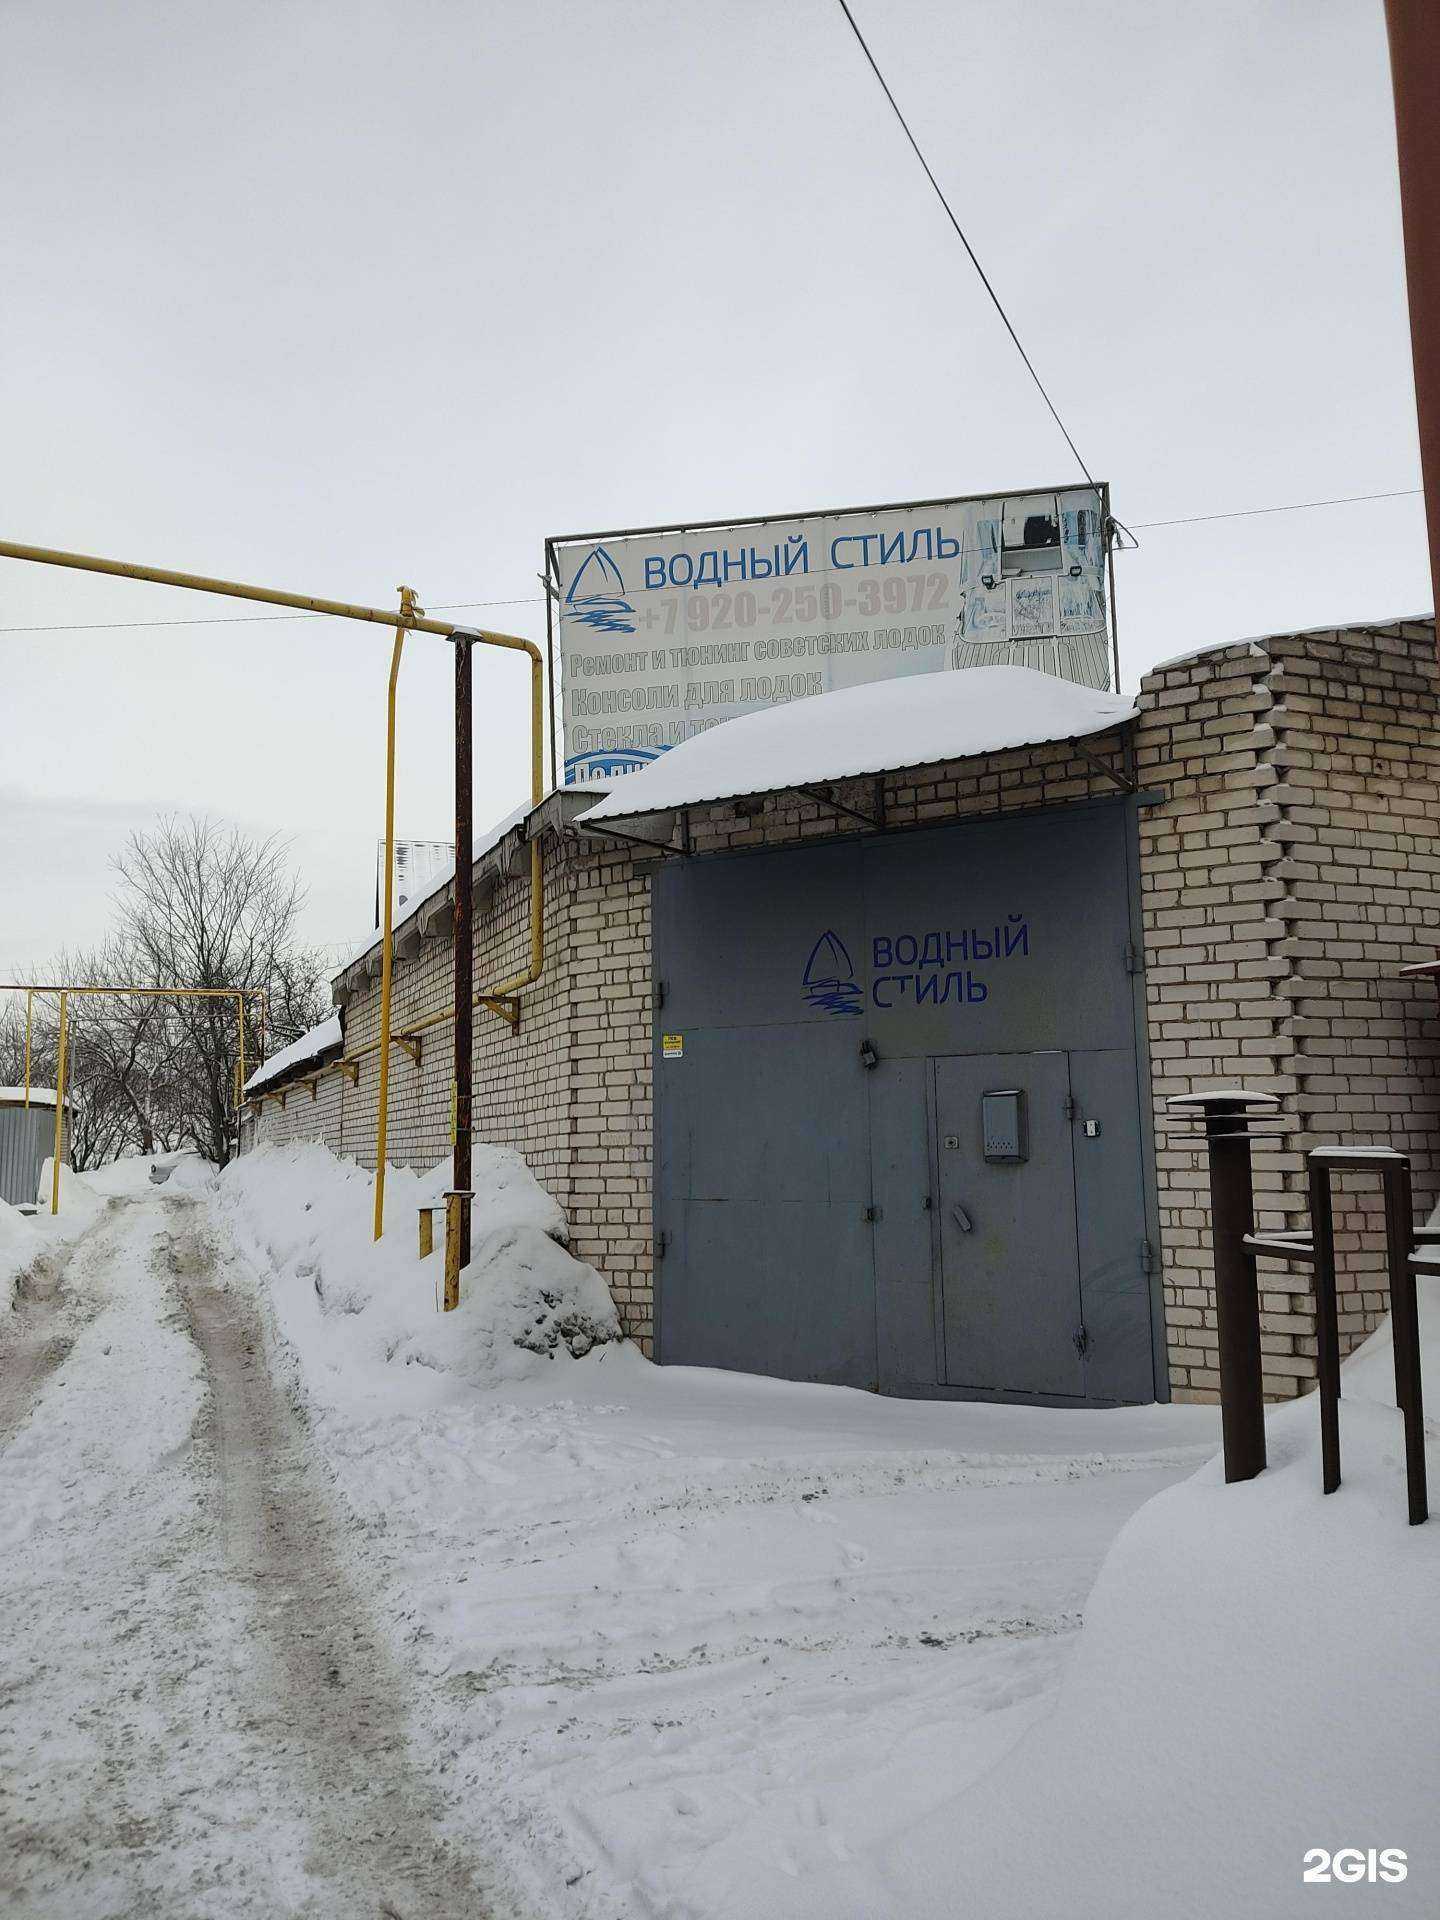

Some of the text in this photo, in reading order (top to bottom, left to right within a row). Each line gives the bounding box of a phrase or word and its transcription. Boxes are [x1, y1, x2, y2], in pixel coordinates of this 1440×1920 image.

[644, 527, 960, 590] ВОДНЫЙ СТИЛЬ
[570, 651, 648, 678] Ремонт
[669, 641, 751, 669] тюнинг
[754, 630, 870, 661] советских
[873, 623, 946, 651] лодок
[571, 671, 823, 717] Консоли для лодок
[572, 720, 664, 754] Стекла
[873, 913, 1030, 970] ВОДНЫЙ
[872, 970, 989, 1008] СТИЛЬ
